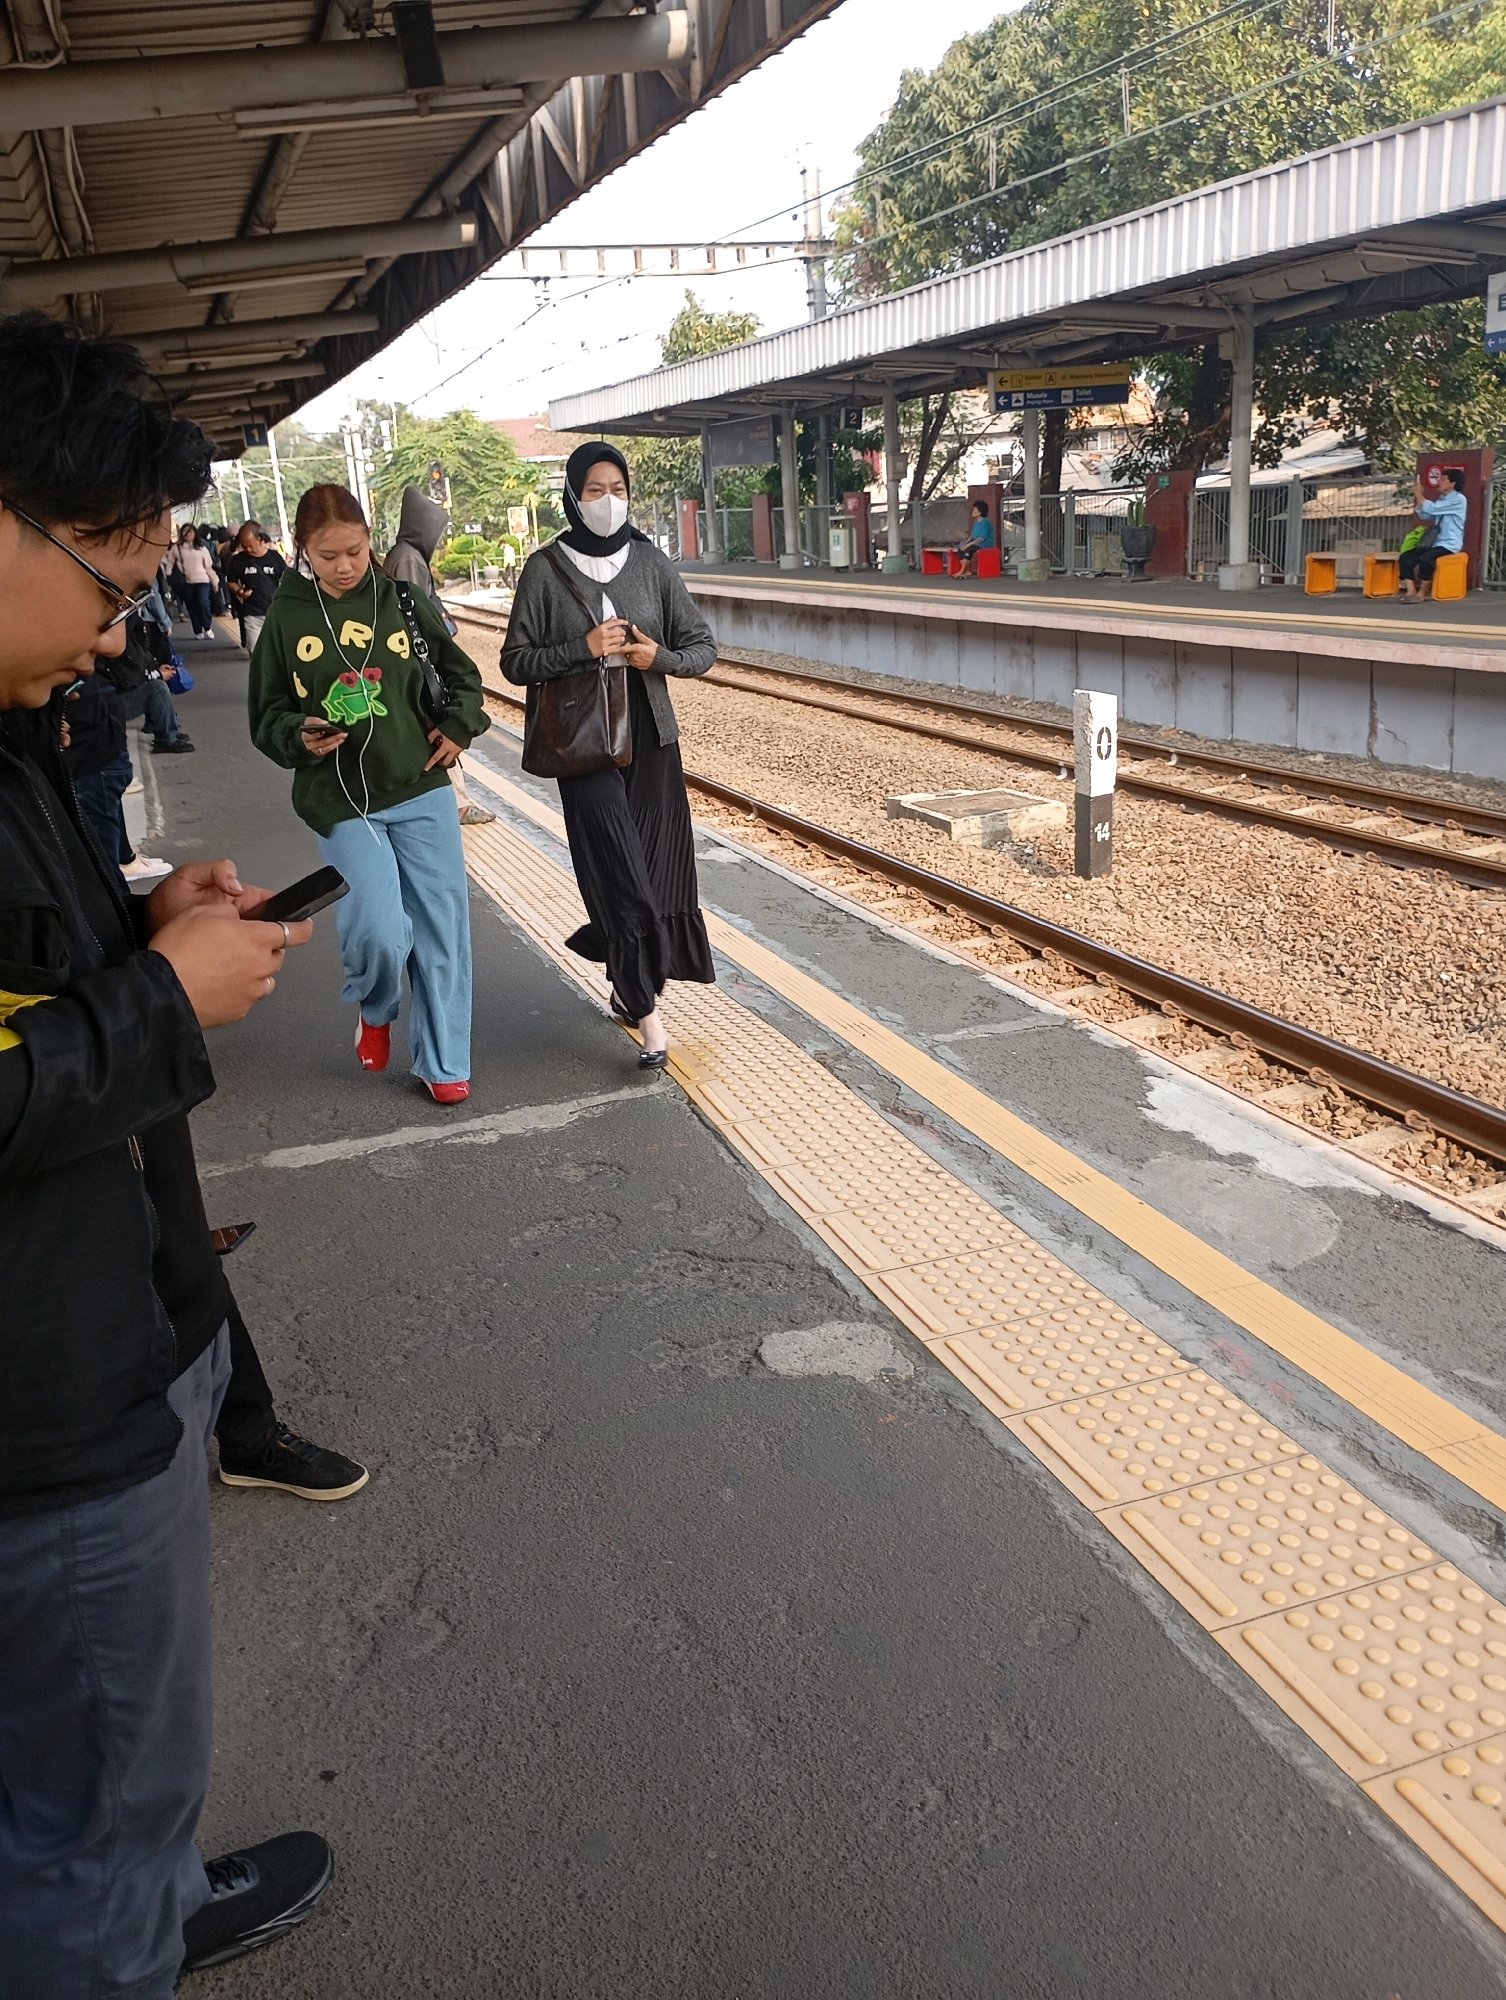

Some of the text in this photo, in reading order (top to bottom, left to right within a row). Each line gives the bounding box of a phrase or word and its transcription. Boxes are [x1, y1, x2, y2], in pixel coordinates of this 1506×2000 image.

[1047, 374, 1055, 383] A
[849, 412, 857, 424] 2
[251, 428, 260, 443] 1
[1096, 726, 1112, 761] 0
[1094, 821, 1111, 843] 14
